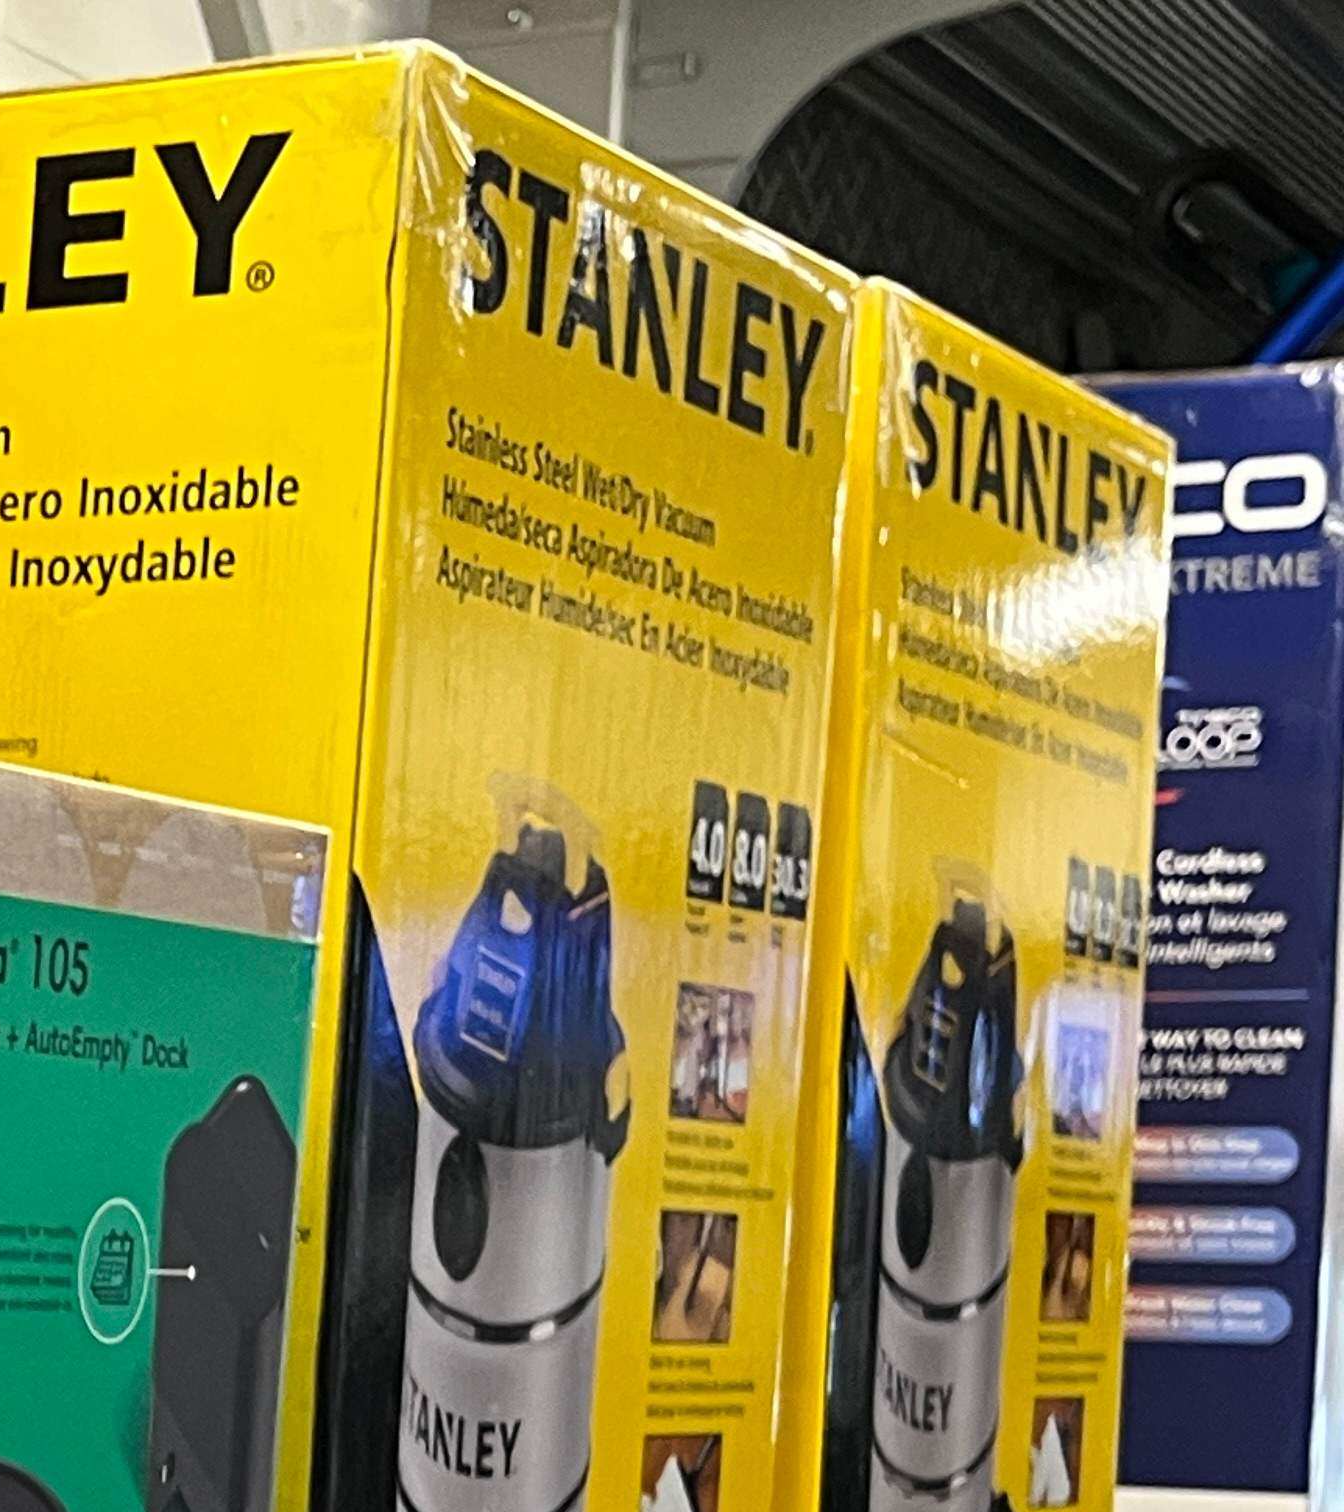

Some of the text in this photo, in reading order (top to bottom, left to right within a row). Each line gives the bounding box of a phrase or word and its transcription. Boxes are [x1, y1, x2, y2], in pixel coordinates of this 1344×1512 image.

[464, 149, 826, 455] STANLEY
[446, 405, 527, 476] Stainless
[534, 441, 578, 494] Steel
[79, 463, 301, 516] Inoxidable
[11, 537, 237, 595] Inoxydable
[33, 933, 91, 997] 105
[141, 1034, 190, 1070] Dock
